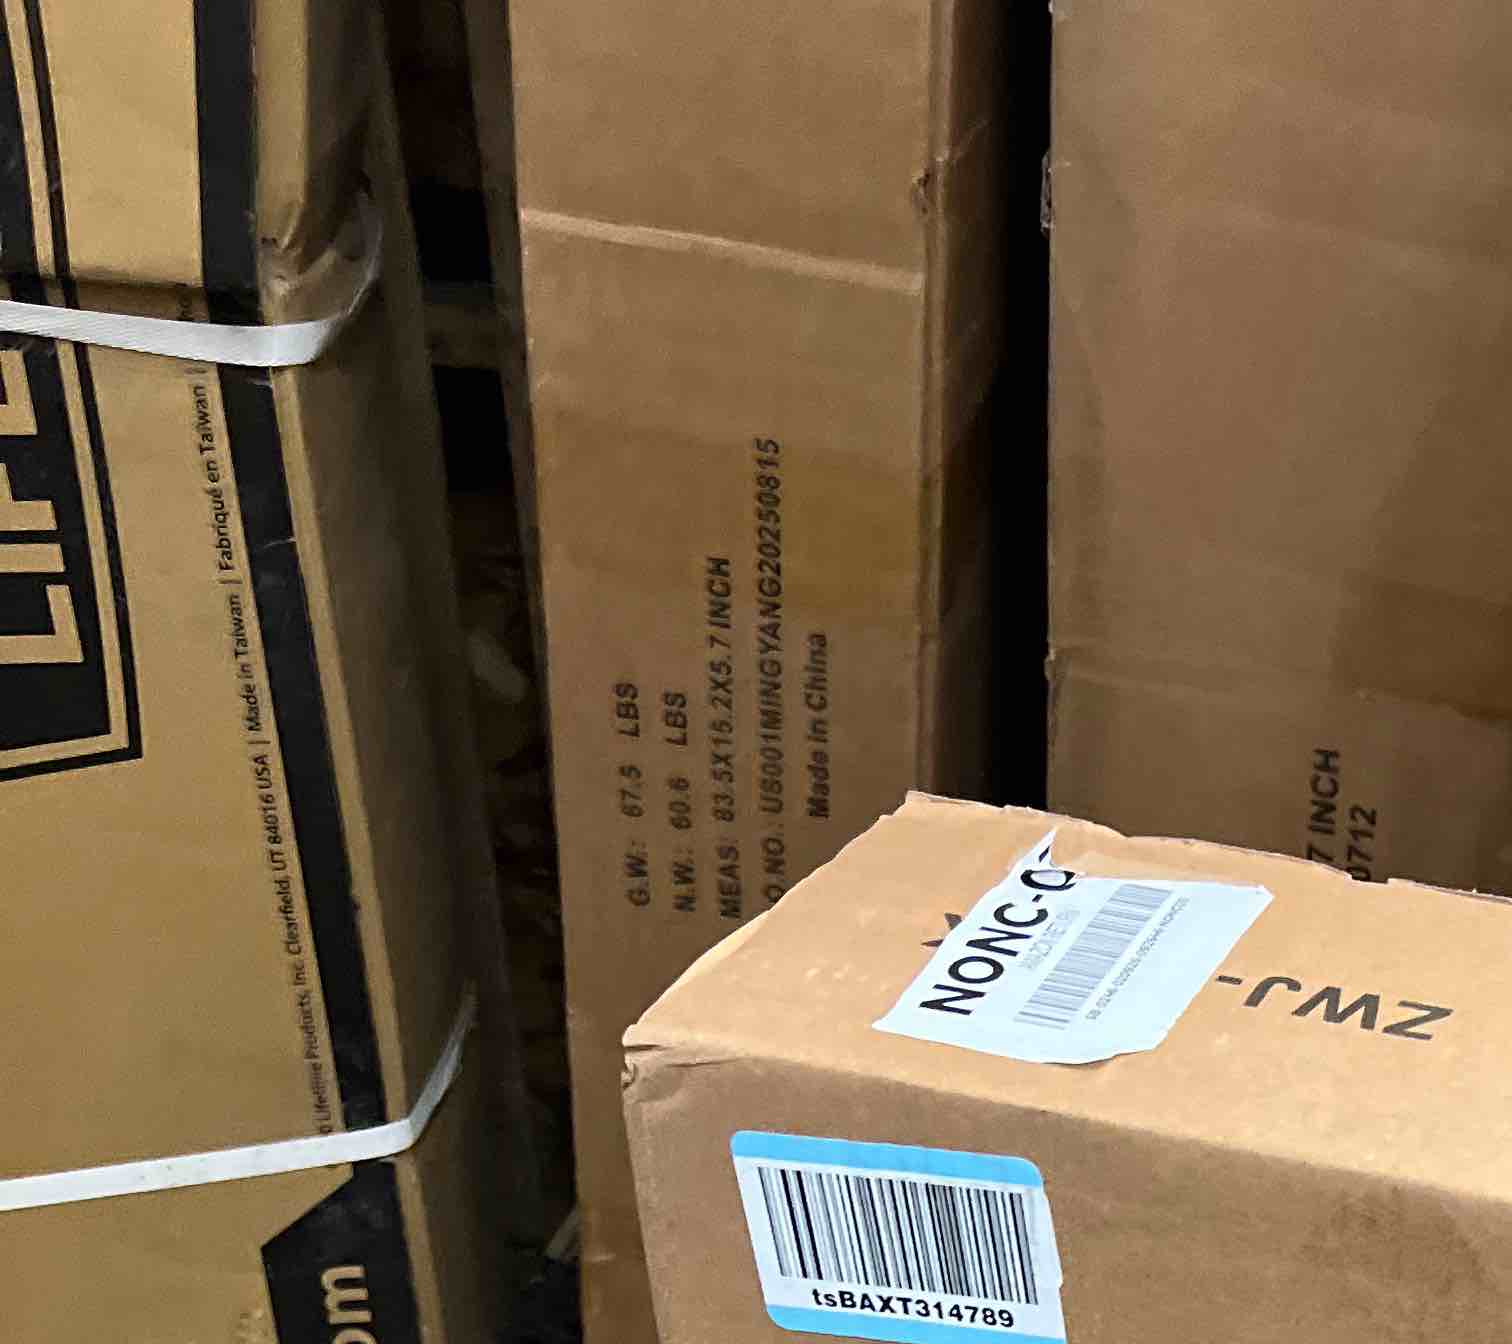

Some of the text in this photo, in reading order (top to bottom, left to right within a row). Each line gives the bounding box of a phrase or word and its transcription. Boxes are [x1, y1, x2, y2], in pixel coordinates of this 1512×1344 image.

[206, 459, 220, 483] en
[206, 487, 234, 571] Fabriqué
[705, 557, 731, 629] INCH
[227, 595, 249, 660] Taiwan
[238, 664, 254, 680] in
[239, 683, 263, 733] Made
[613, 682, 641, 739] LBS
[664, 691, 688, 746] LBS
[804, 633, 830, 819] Made in China
[253, 754, 272, 790] USA
[619, 764, 643, 818] 67.5
[1308, 748, 1341, 836] INCH
[258, 792, 283, 846] 84016
[269, 850, 287, 872] UT
[812, 1288, 1015, 1329] tsBAXT314789
